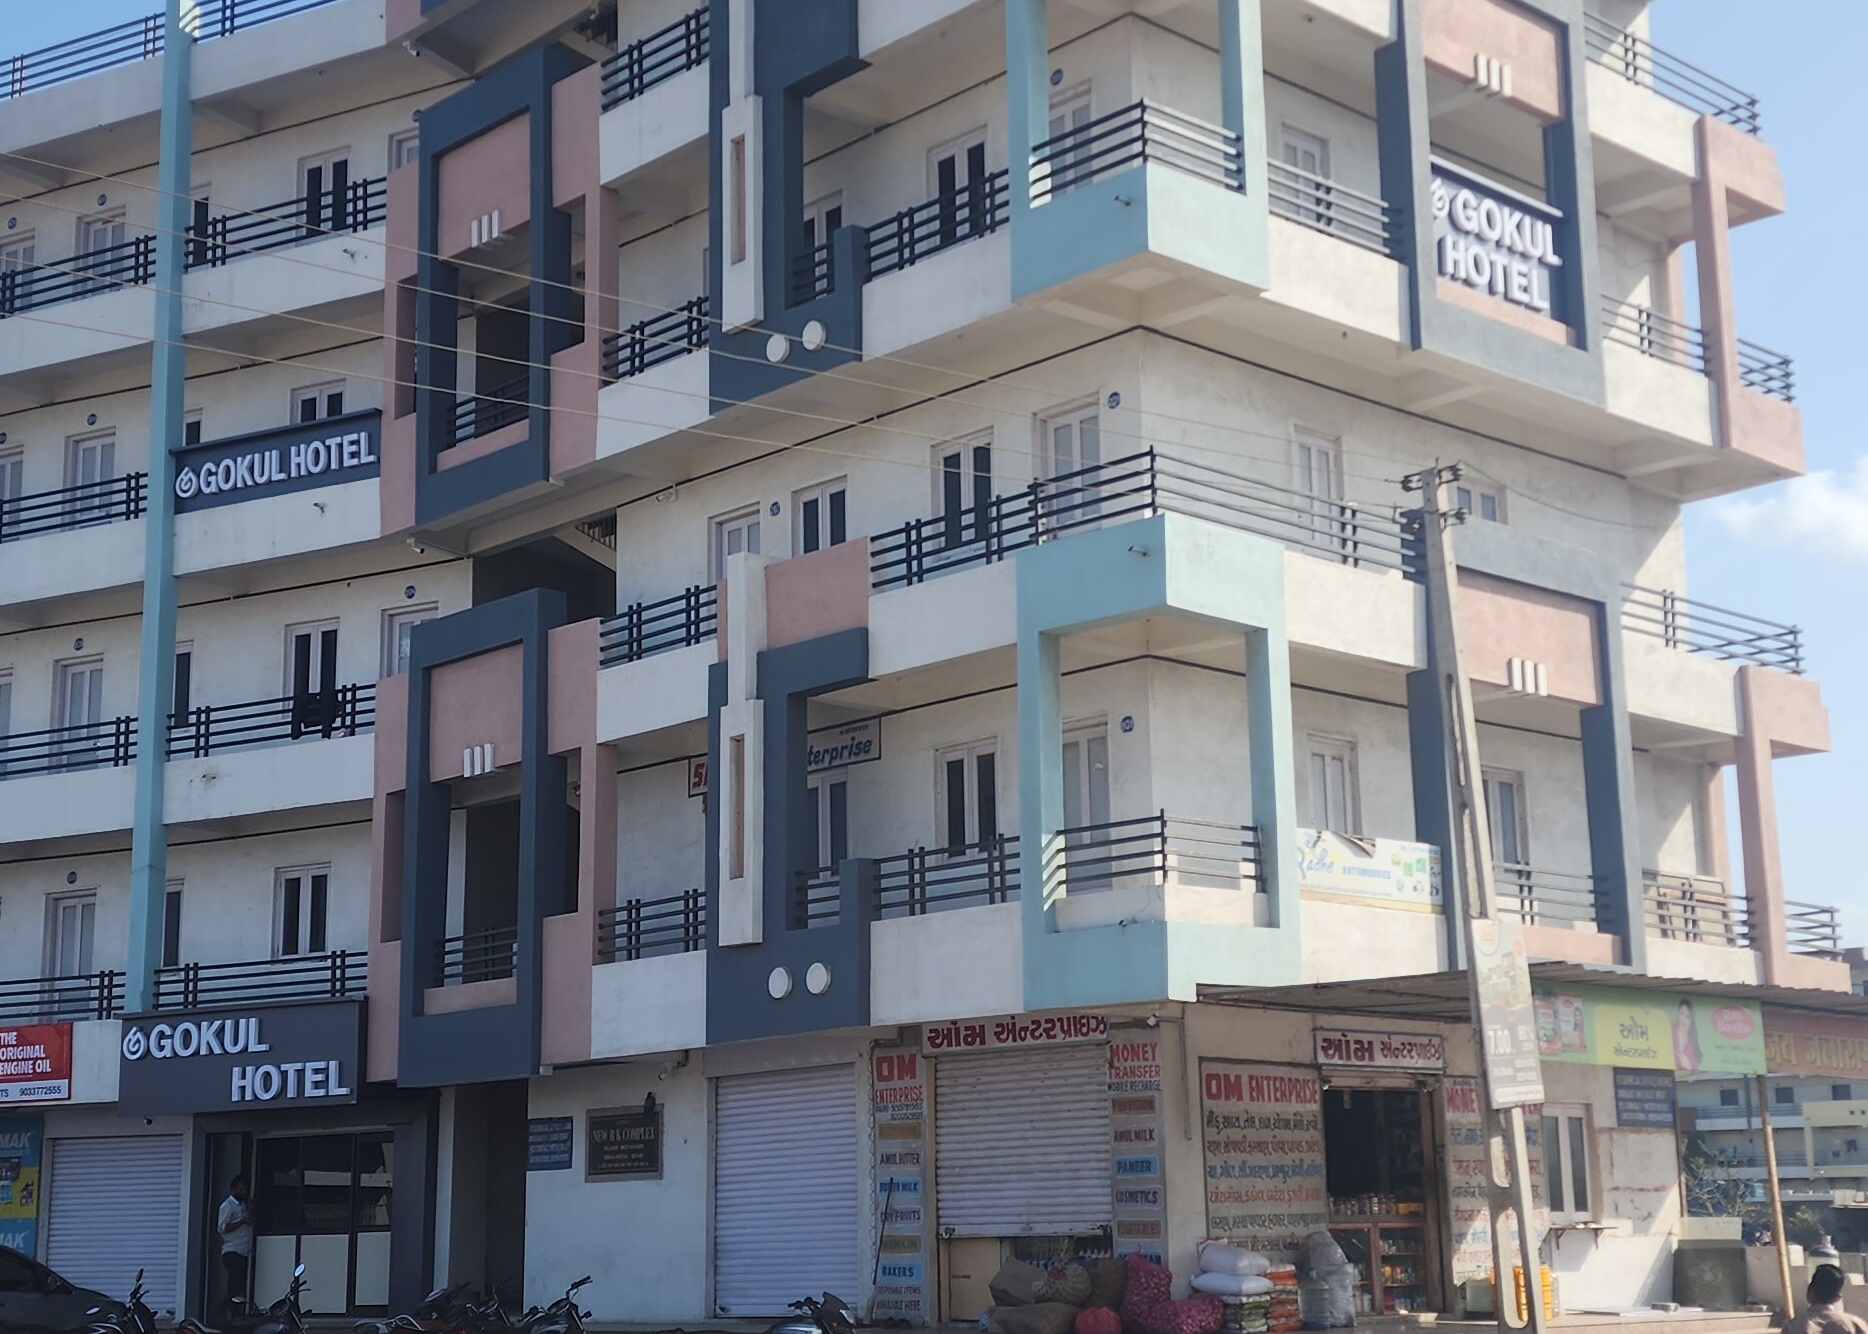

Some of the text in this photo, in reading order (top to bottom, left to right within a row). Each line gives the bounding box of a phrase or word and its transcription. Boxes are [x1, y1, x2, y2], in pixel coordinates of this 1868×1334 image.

[1450, 188, 1563, 267] GOKUL
[1438, 234, 1550, 313] HOTEL
[200, 431, 378, 495] GOKUL HOTEL
[808, 736, 872, 766] terprise
[0, 1031, 18, 1046] THE
[149, 1017, 270, 1059] GOKUL
[0, 1044, 46, 1061] ORIGINAL
[1109, 1042, 1158, 1063] MONEY
[0, 1058, 52, 1075] ENGINE OIL
[875, 1053, 917, 1083] OM
[1108, 1064, 1161, 1080] TRANSFER
[231, 1060, 350, 1103] HOTEL
[1204, 1073, 1318, 1104] OM ENTERPRISE
[875, 1085, 924, 1105] ENTERPRISE
[1446, 1087, 1478, 1113] MONE
[1134, 1128, 1155, 1142] MILK
[1117, 1160, 1152, 1175] PANEER
[1115, 1190, 1158, 1204] COSMETICS
[881, 1266, 915, 1278] BAKERS
